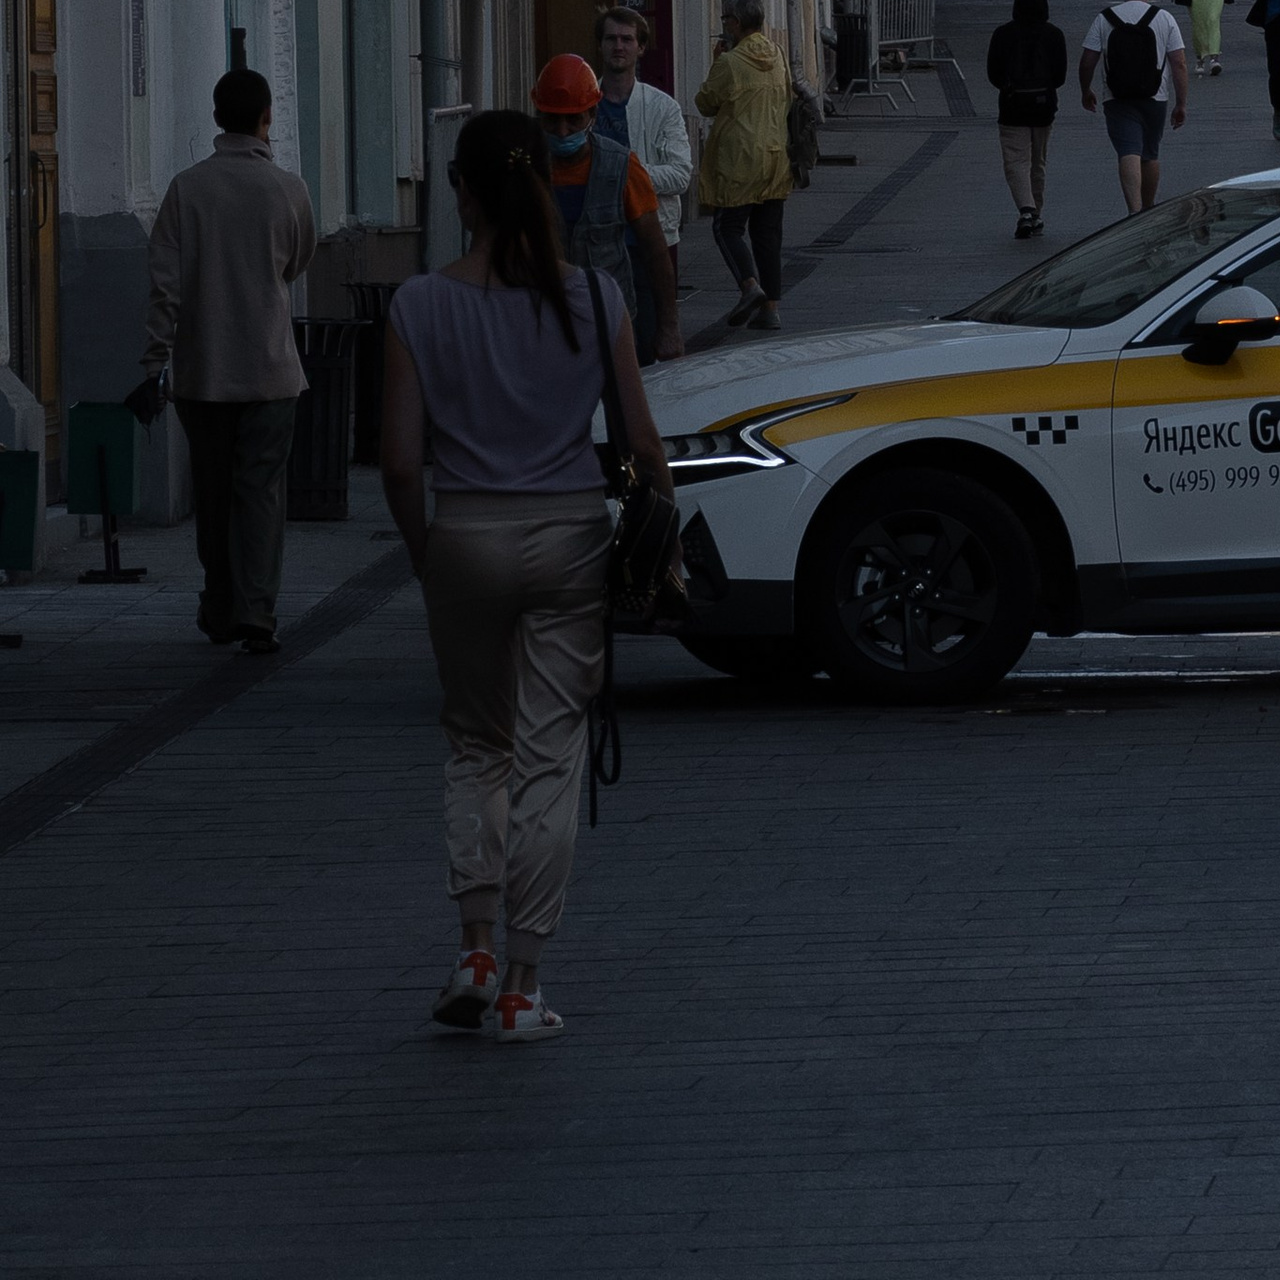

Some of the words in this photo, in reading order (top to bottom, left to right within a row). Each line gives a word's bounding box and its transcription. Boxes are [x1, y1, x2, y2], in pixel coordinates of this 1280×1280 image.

[1143, 417, 1242, 455] Яндекс
[1169, 469, 1216, 494] (495)
[1225, 465, 1260, 489] 999
